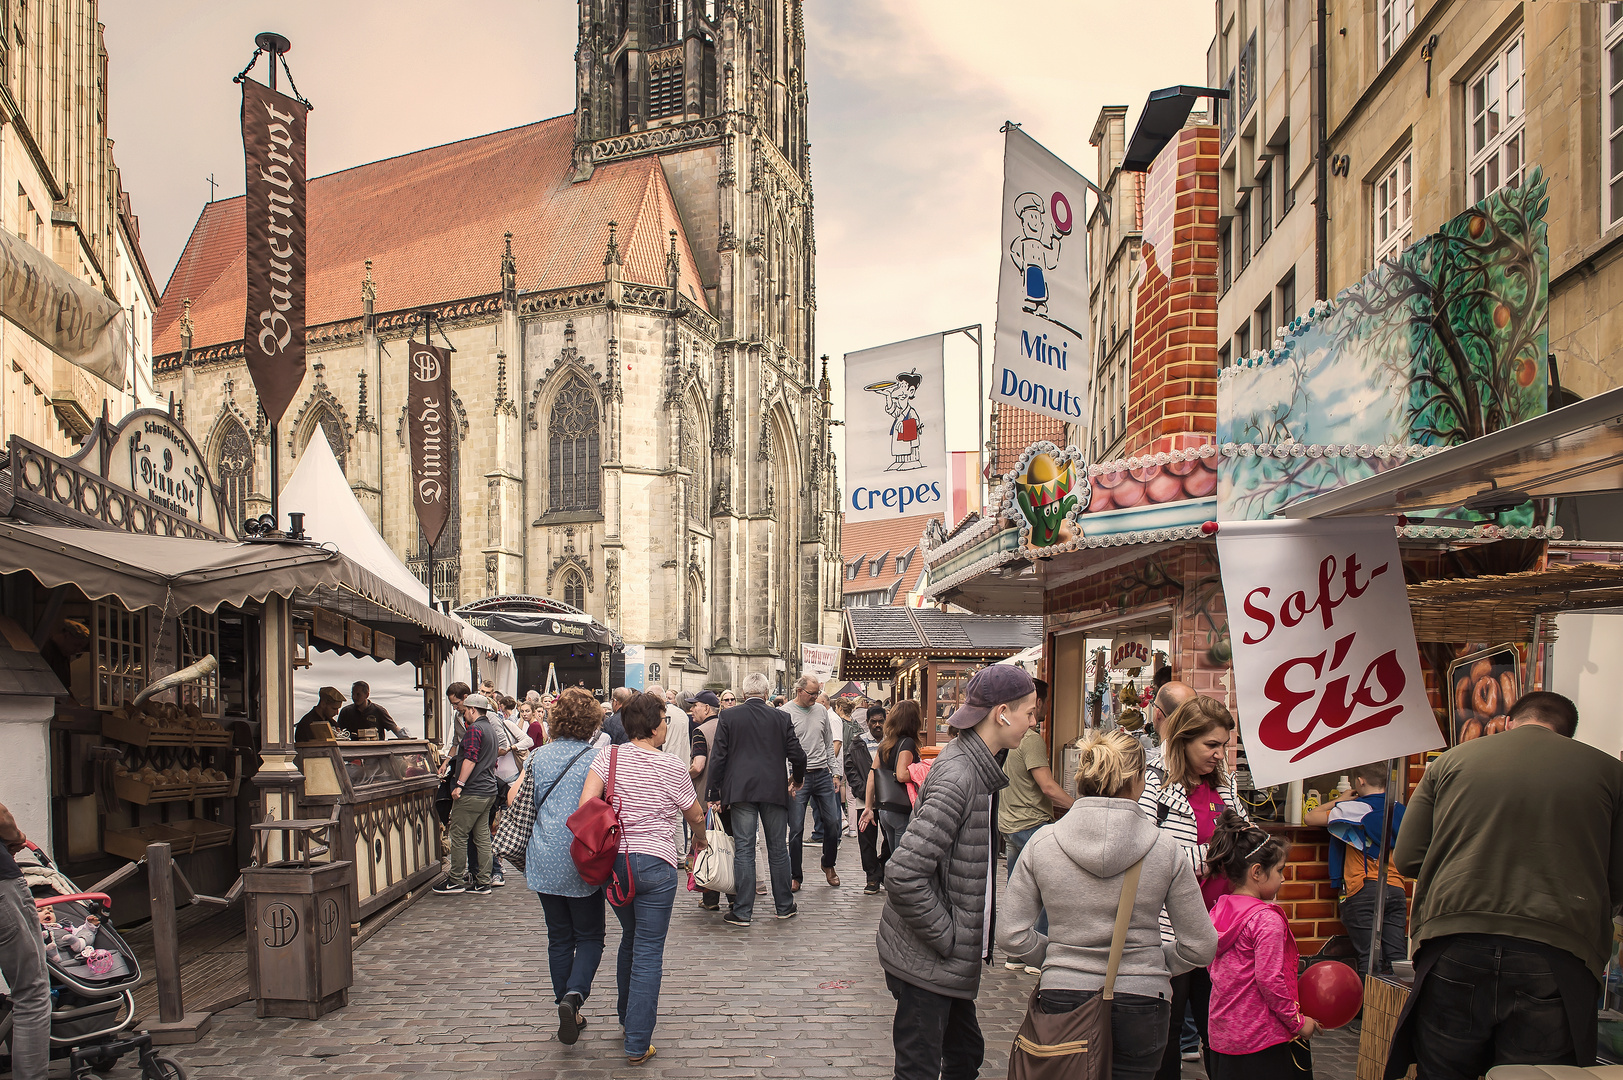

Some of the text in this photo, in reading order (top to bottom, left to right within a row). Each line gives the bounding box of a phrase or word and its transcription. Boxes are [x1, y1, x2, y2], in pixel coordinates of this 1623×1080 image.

[258, 99, 295, 357] Bauernbrot
[1020, 329, 1068, 372] Mini
[1000, 367, 1082, 418] Donuts
[144, 420, 189, 456] Schwäbische
[418, 396, 442, 505] Dinnede
[140, 456, 195, 507] Dinnede
[852, 481, 941, 513] Crepes
[1242, 552, 1389, 645] Soft-
[1113, 641, 1149, 666] CREPES
[1258, 631, 1407, 752] Eis
